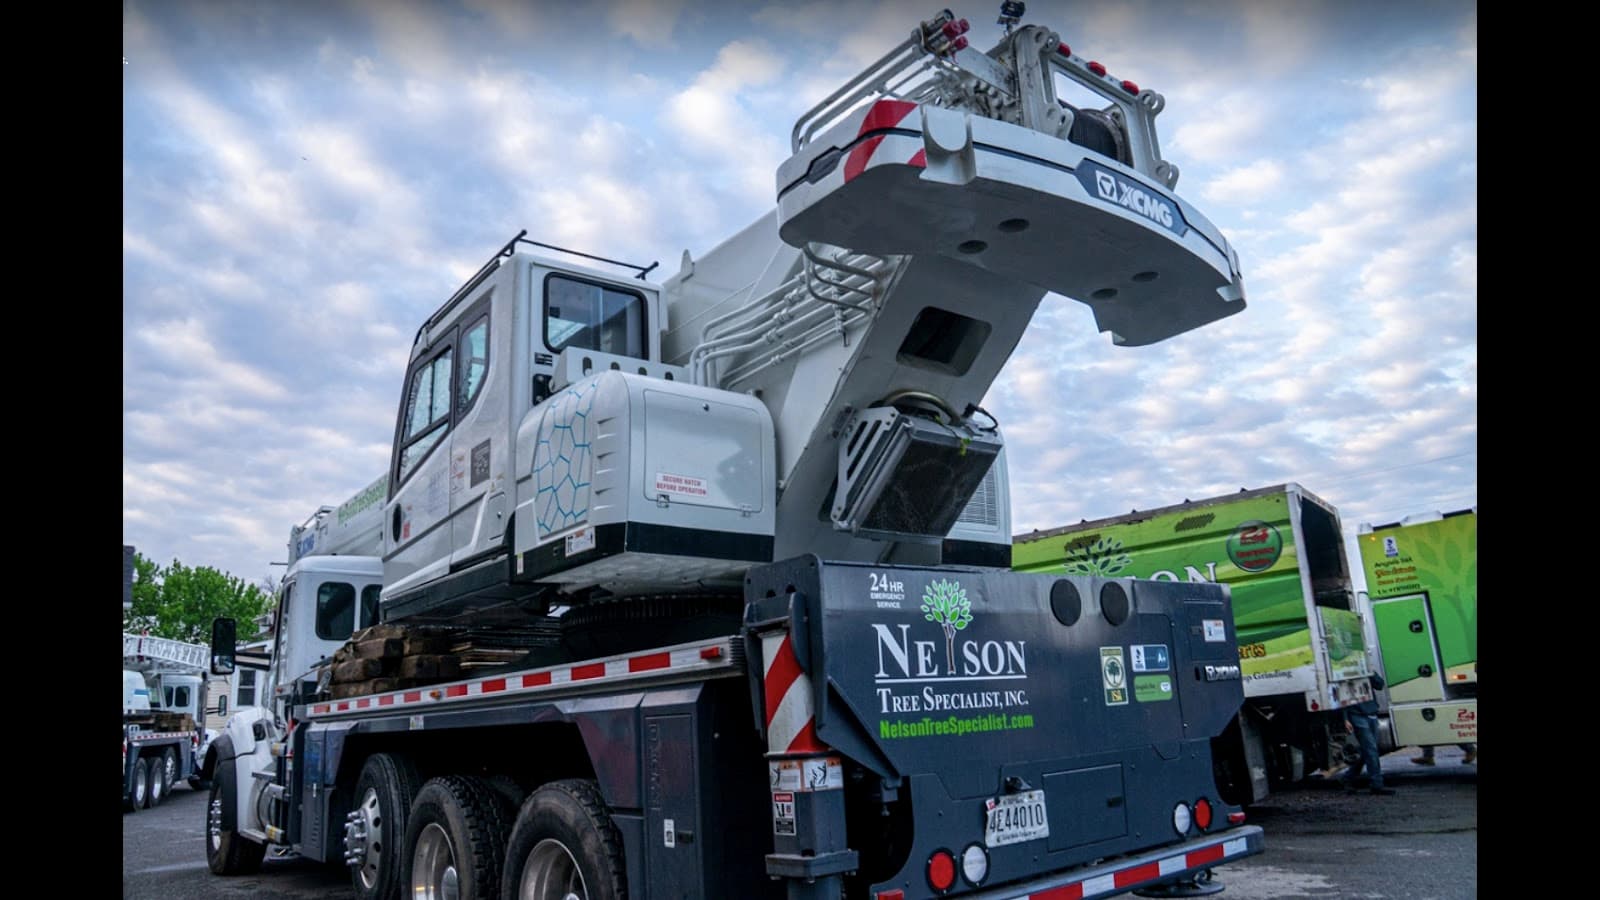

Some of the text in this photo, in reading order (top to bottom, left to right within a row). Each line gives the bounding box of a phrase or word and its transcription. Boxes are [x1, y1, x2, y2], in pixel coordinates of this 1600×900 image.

[1118, 181, 1174, 228] XCMG
[656, 482, 707, 496] BEFORE OPERATION
[662, 475, 701, 487] SECURE HATCH
[869, 573, 905, 593] 24 HR
[870, 592, 905, 600] EMERGENCY
[876, 601, 902, 609] SERVICE
[876, 686, 1029, 714] TREE SPECIALIST, INC.
[1457, 708, 1475, 721] 24
[879, 713, 1034, 740] NelsonTreeSpecialist.com
[989, 803, 1044, 833] 4E44010
